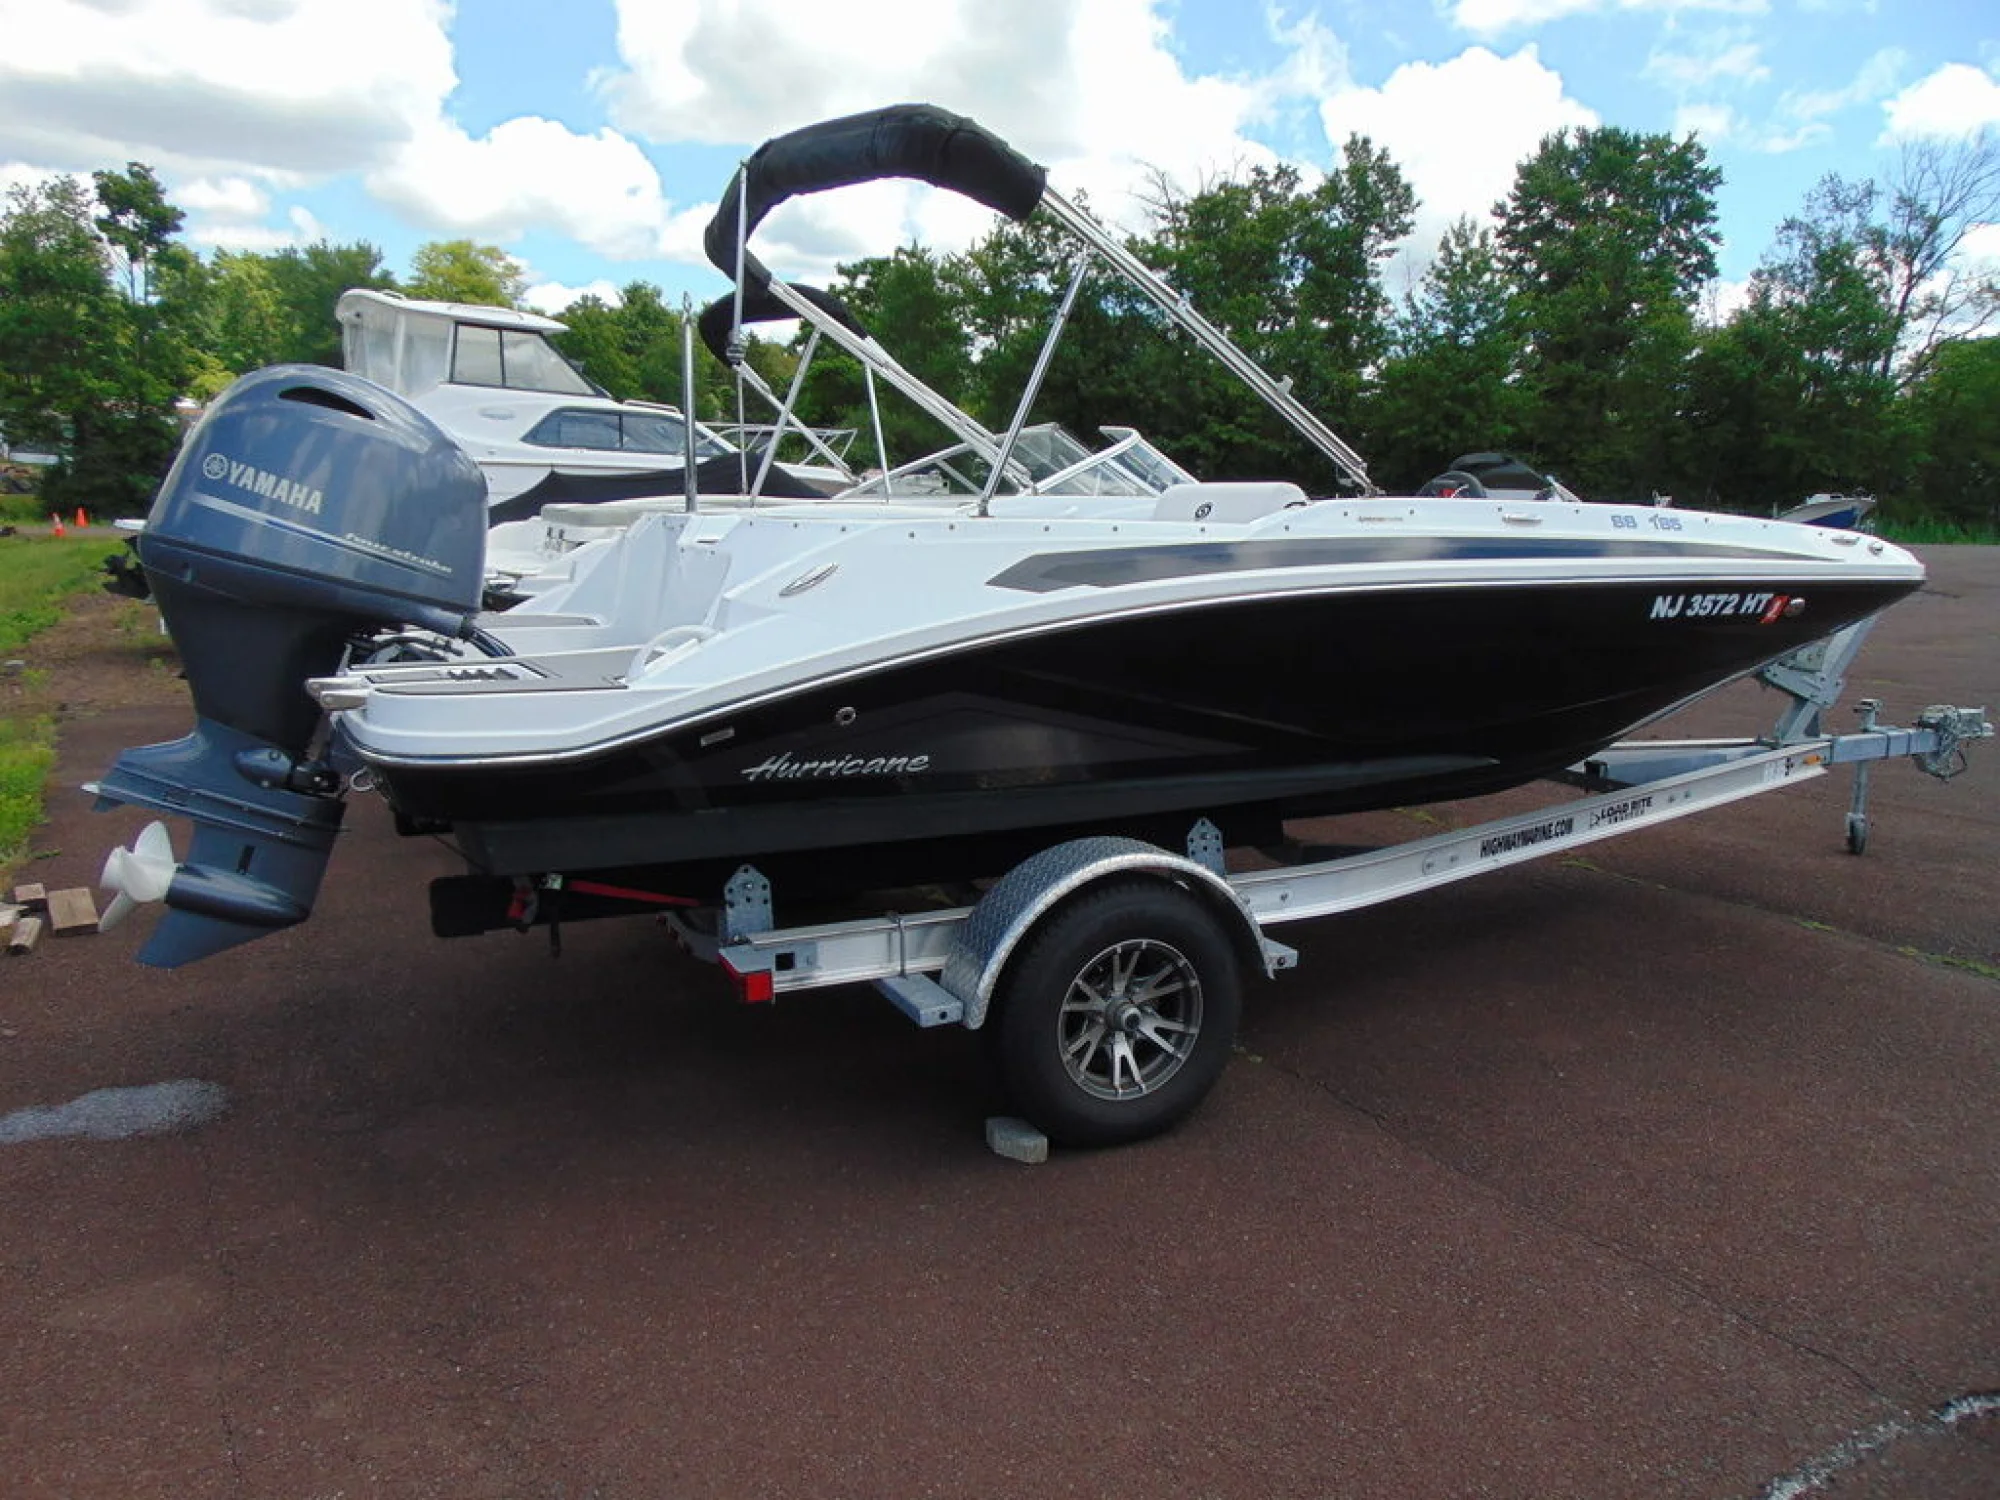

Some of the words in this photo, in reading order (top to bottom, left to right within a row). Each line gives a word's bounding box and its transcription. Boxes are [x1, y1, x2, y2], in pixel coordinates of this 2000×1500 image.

[228, 461, 323, 514] YAMAHA
[1650, 595, 1686, 619] NJ
[1686, 594, 1739, 616] 3572
[1740, 593, 1774, 614] HT
[741, 752, 928, 781] Hurricane
